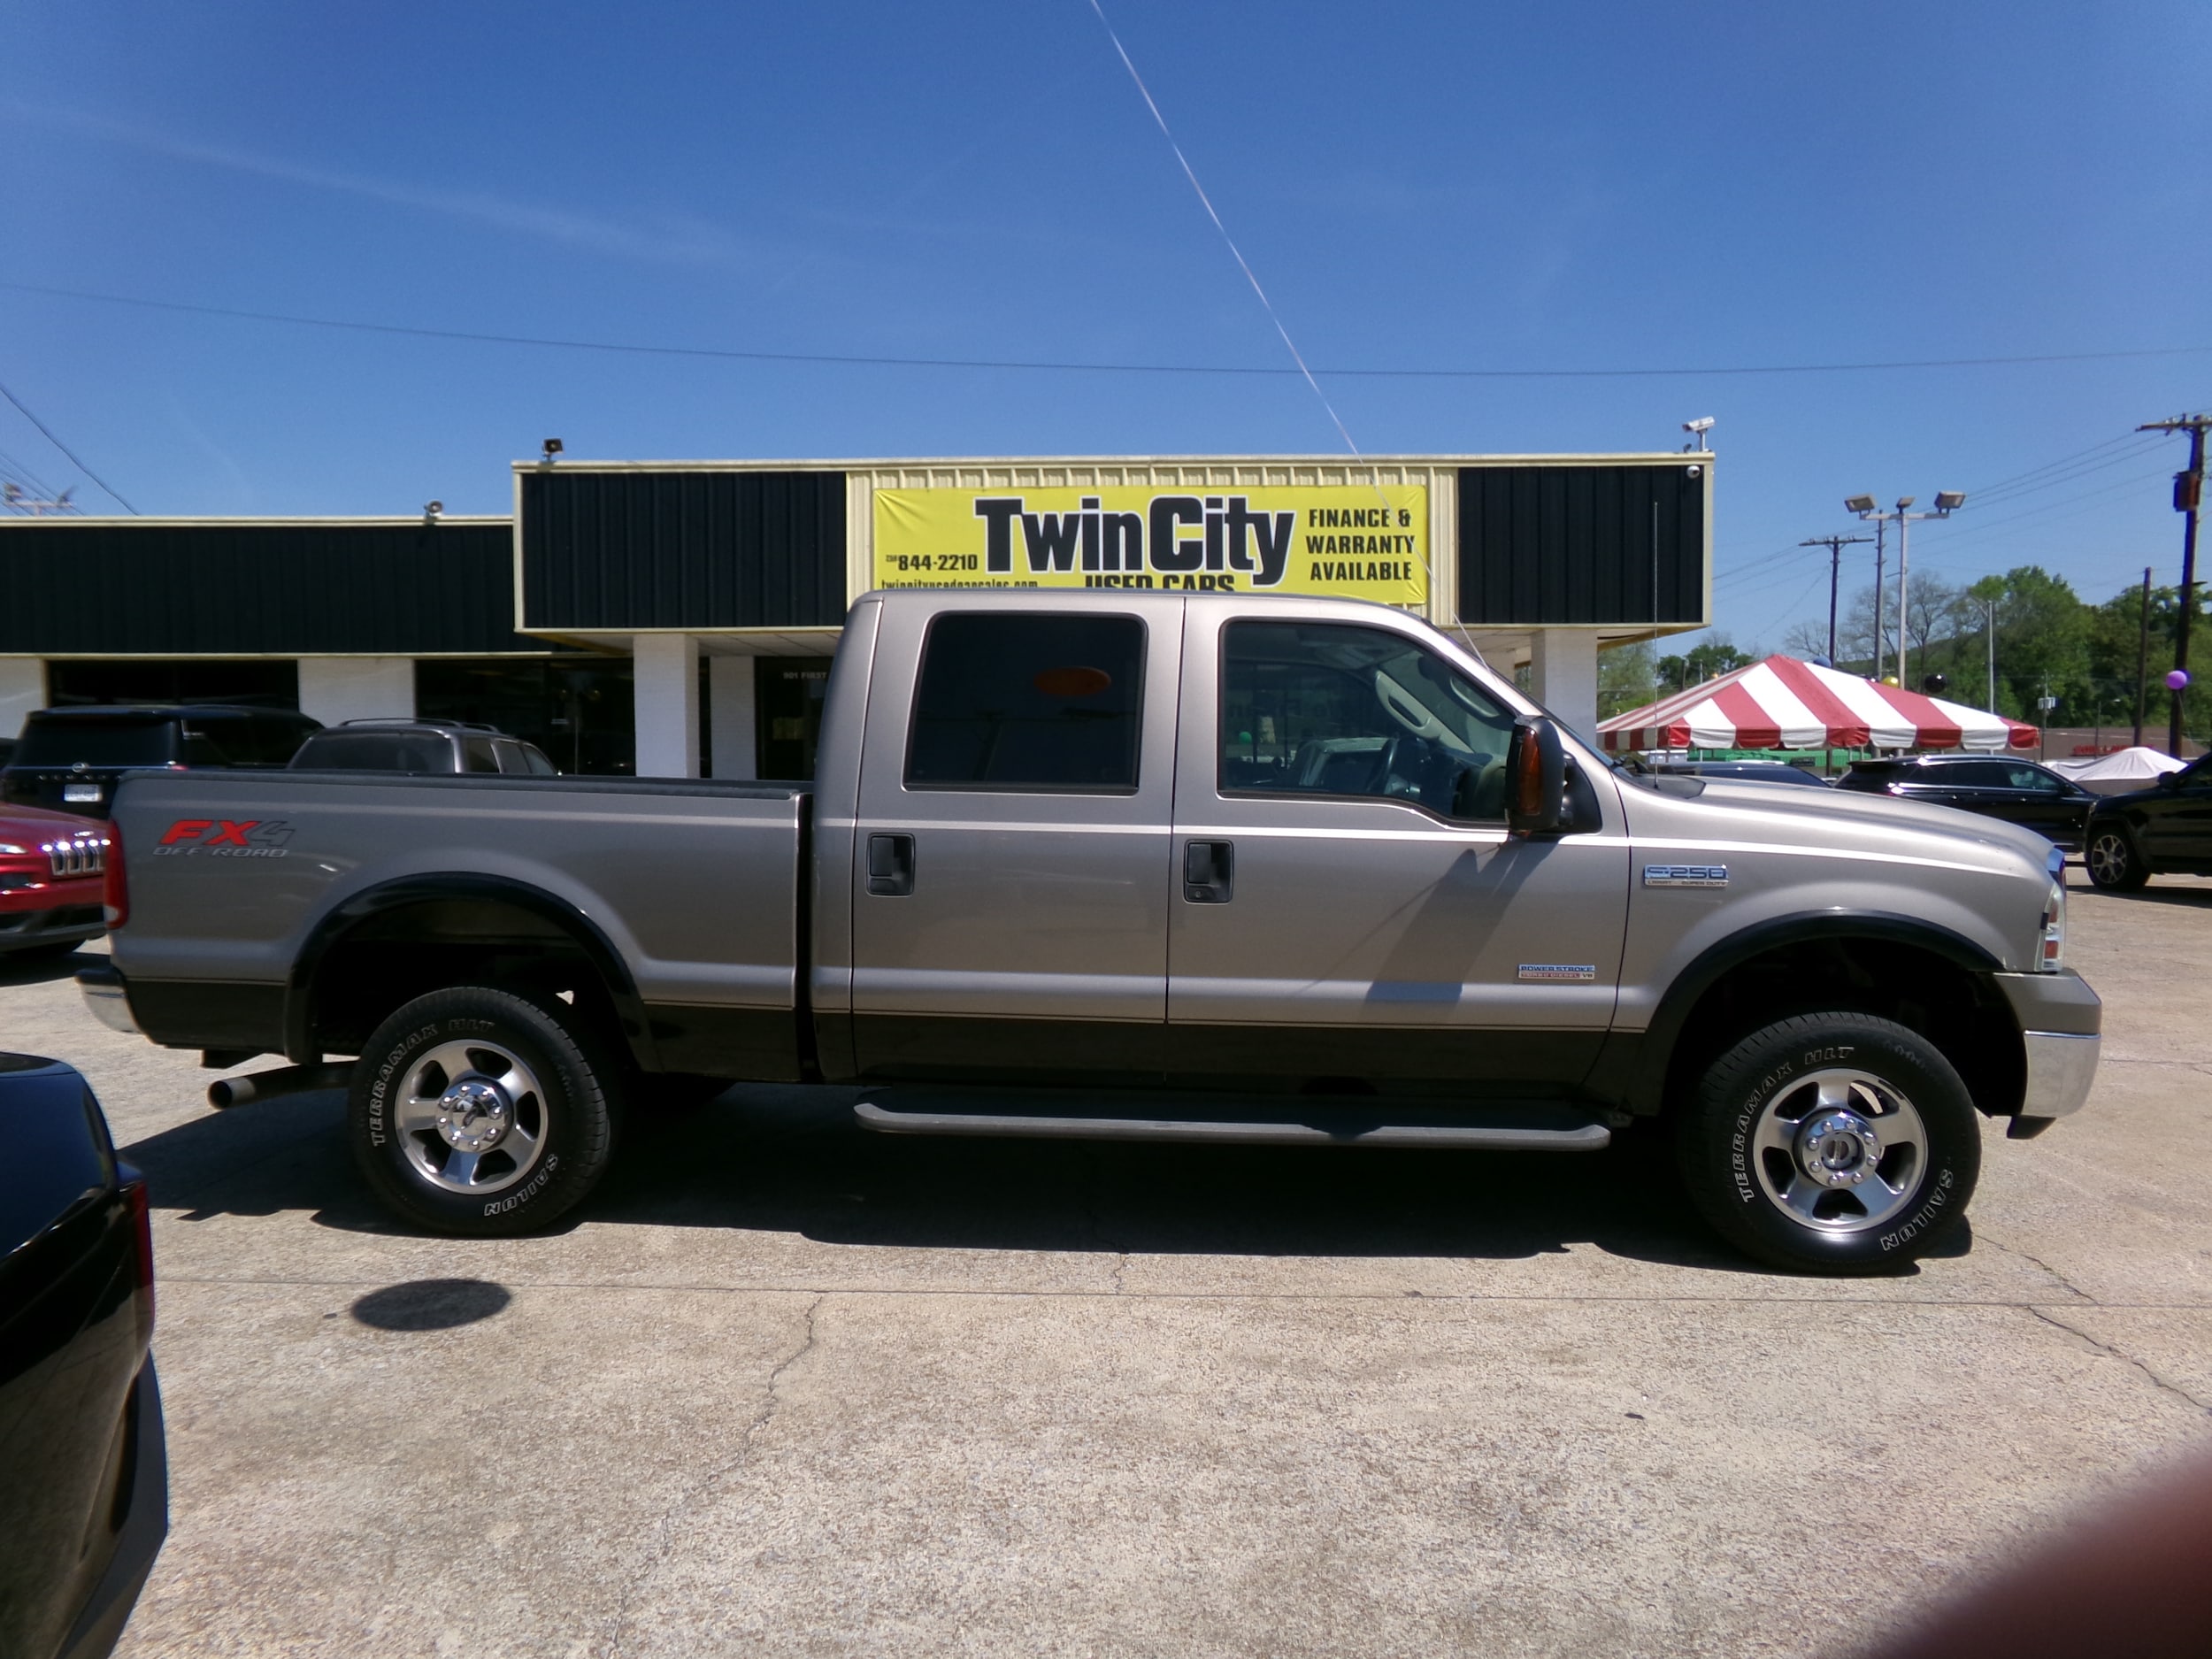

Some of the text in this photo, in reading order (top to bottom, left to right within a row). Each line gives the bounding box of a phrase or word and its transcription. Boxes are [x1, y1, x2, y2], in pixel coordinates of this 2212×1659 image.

[1309, 508, 1411, 528] FINANCE &
[1305, 534, 1416, 555] WARRANTY
[897, 554, 979, 572] 844-2210
[1310, 561, 1413, 581] AVAILABLE
[158, 818, 296, 847] FX4
[152, 847, 289, 858] OFF ROAD
[483, 1153, 559, 1217] SAILUN
[1880, 1169, 1955, 1251] SAILUN
